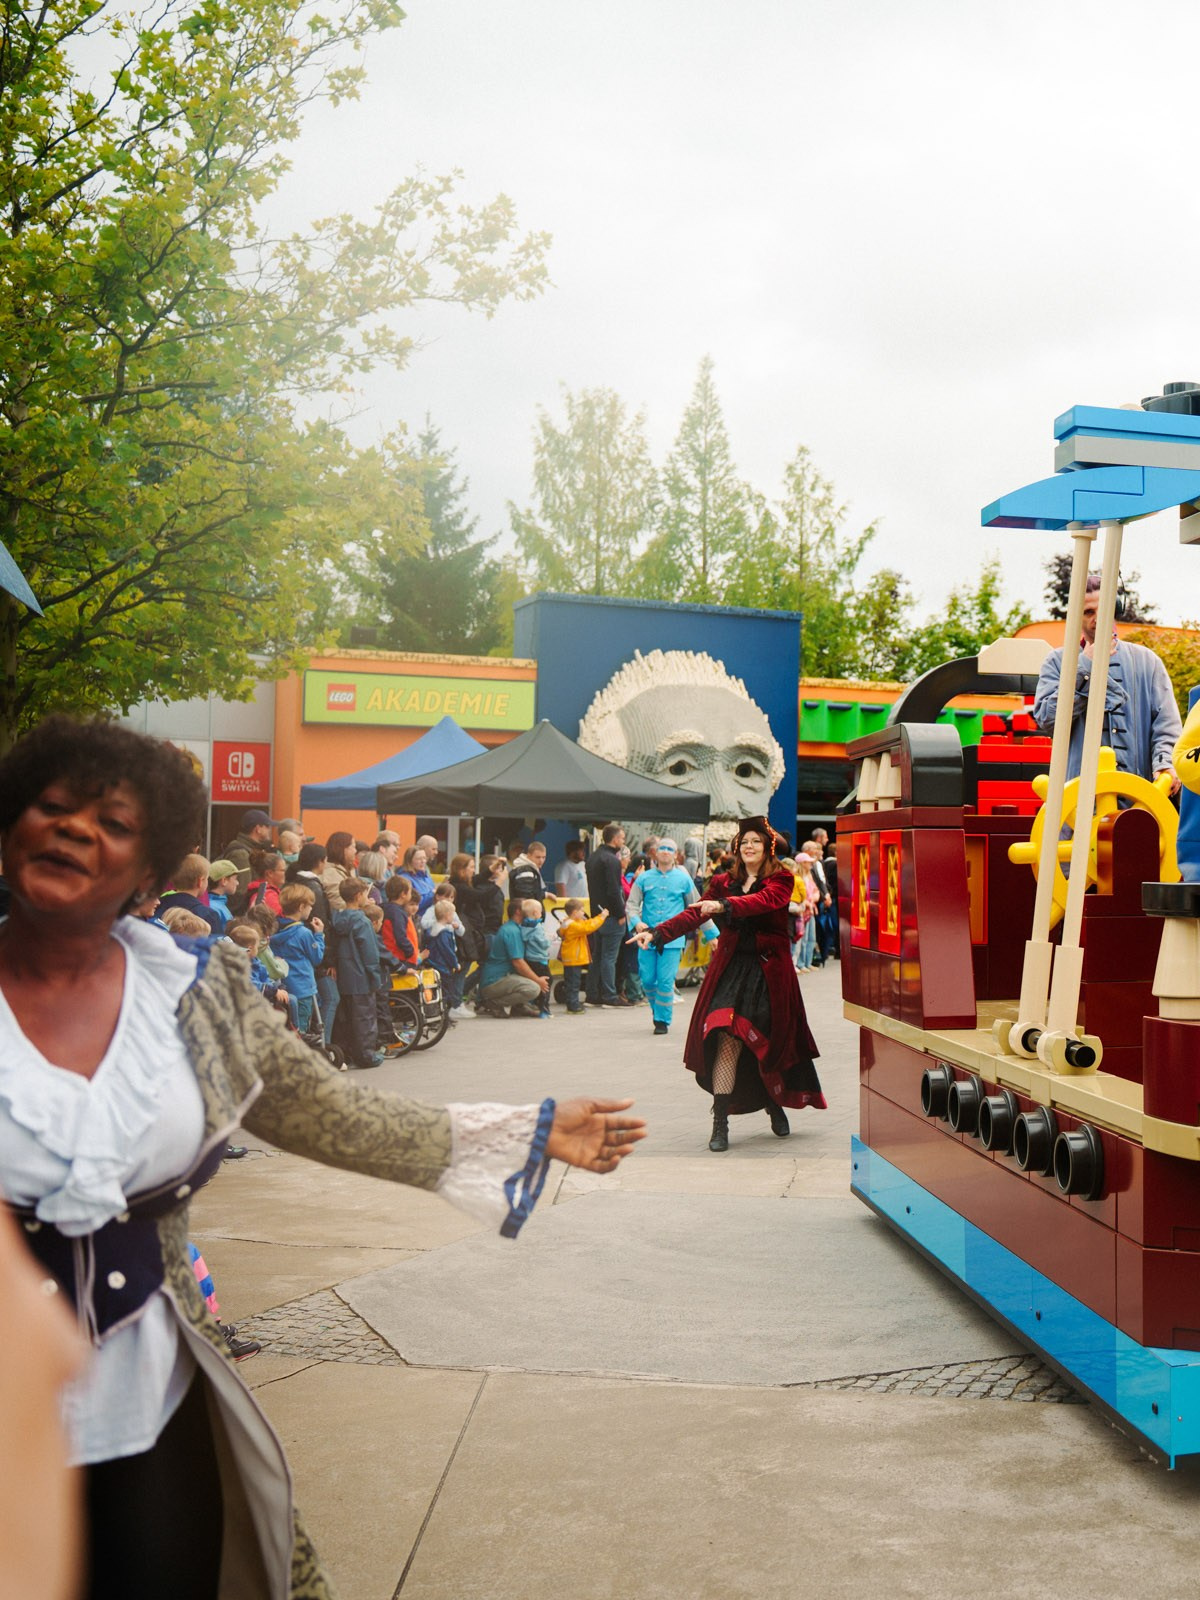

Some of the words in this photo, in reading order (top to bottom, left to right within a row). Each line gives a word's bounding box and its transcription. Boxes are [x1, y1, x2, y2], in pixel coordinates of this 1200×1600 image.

[329, 691, 354, 702] LEGO
[366, 687, 511, 716] AKADEMIE
[221, 784, 260, 792] SWITCH
